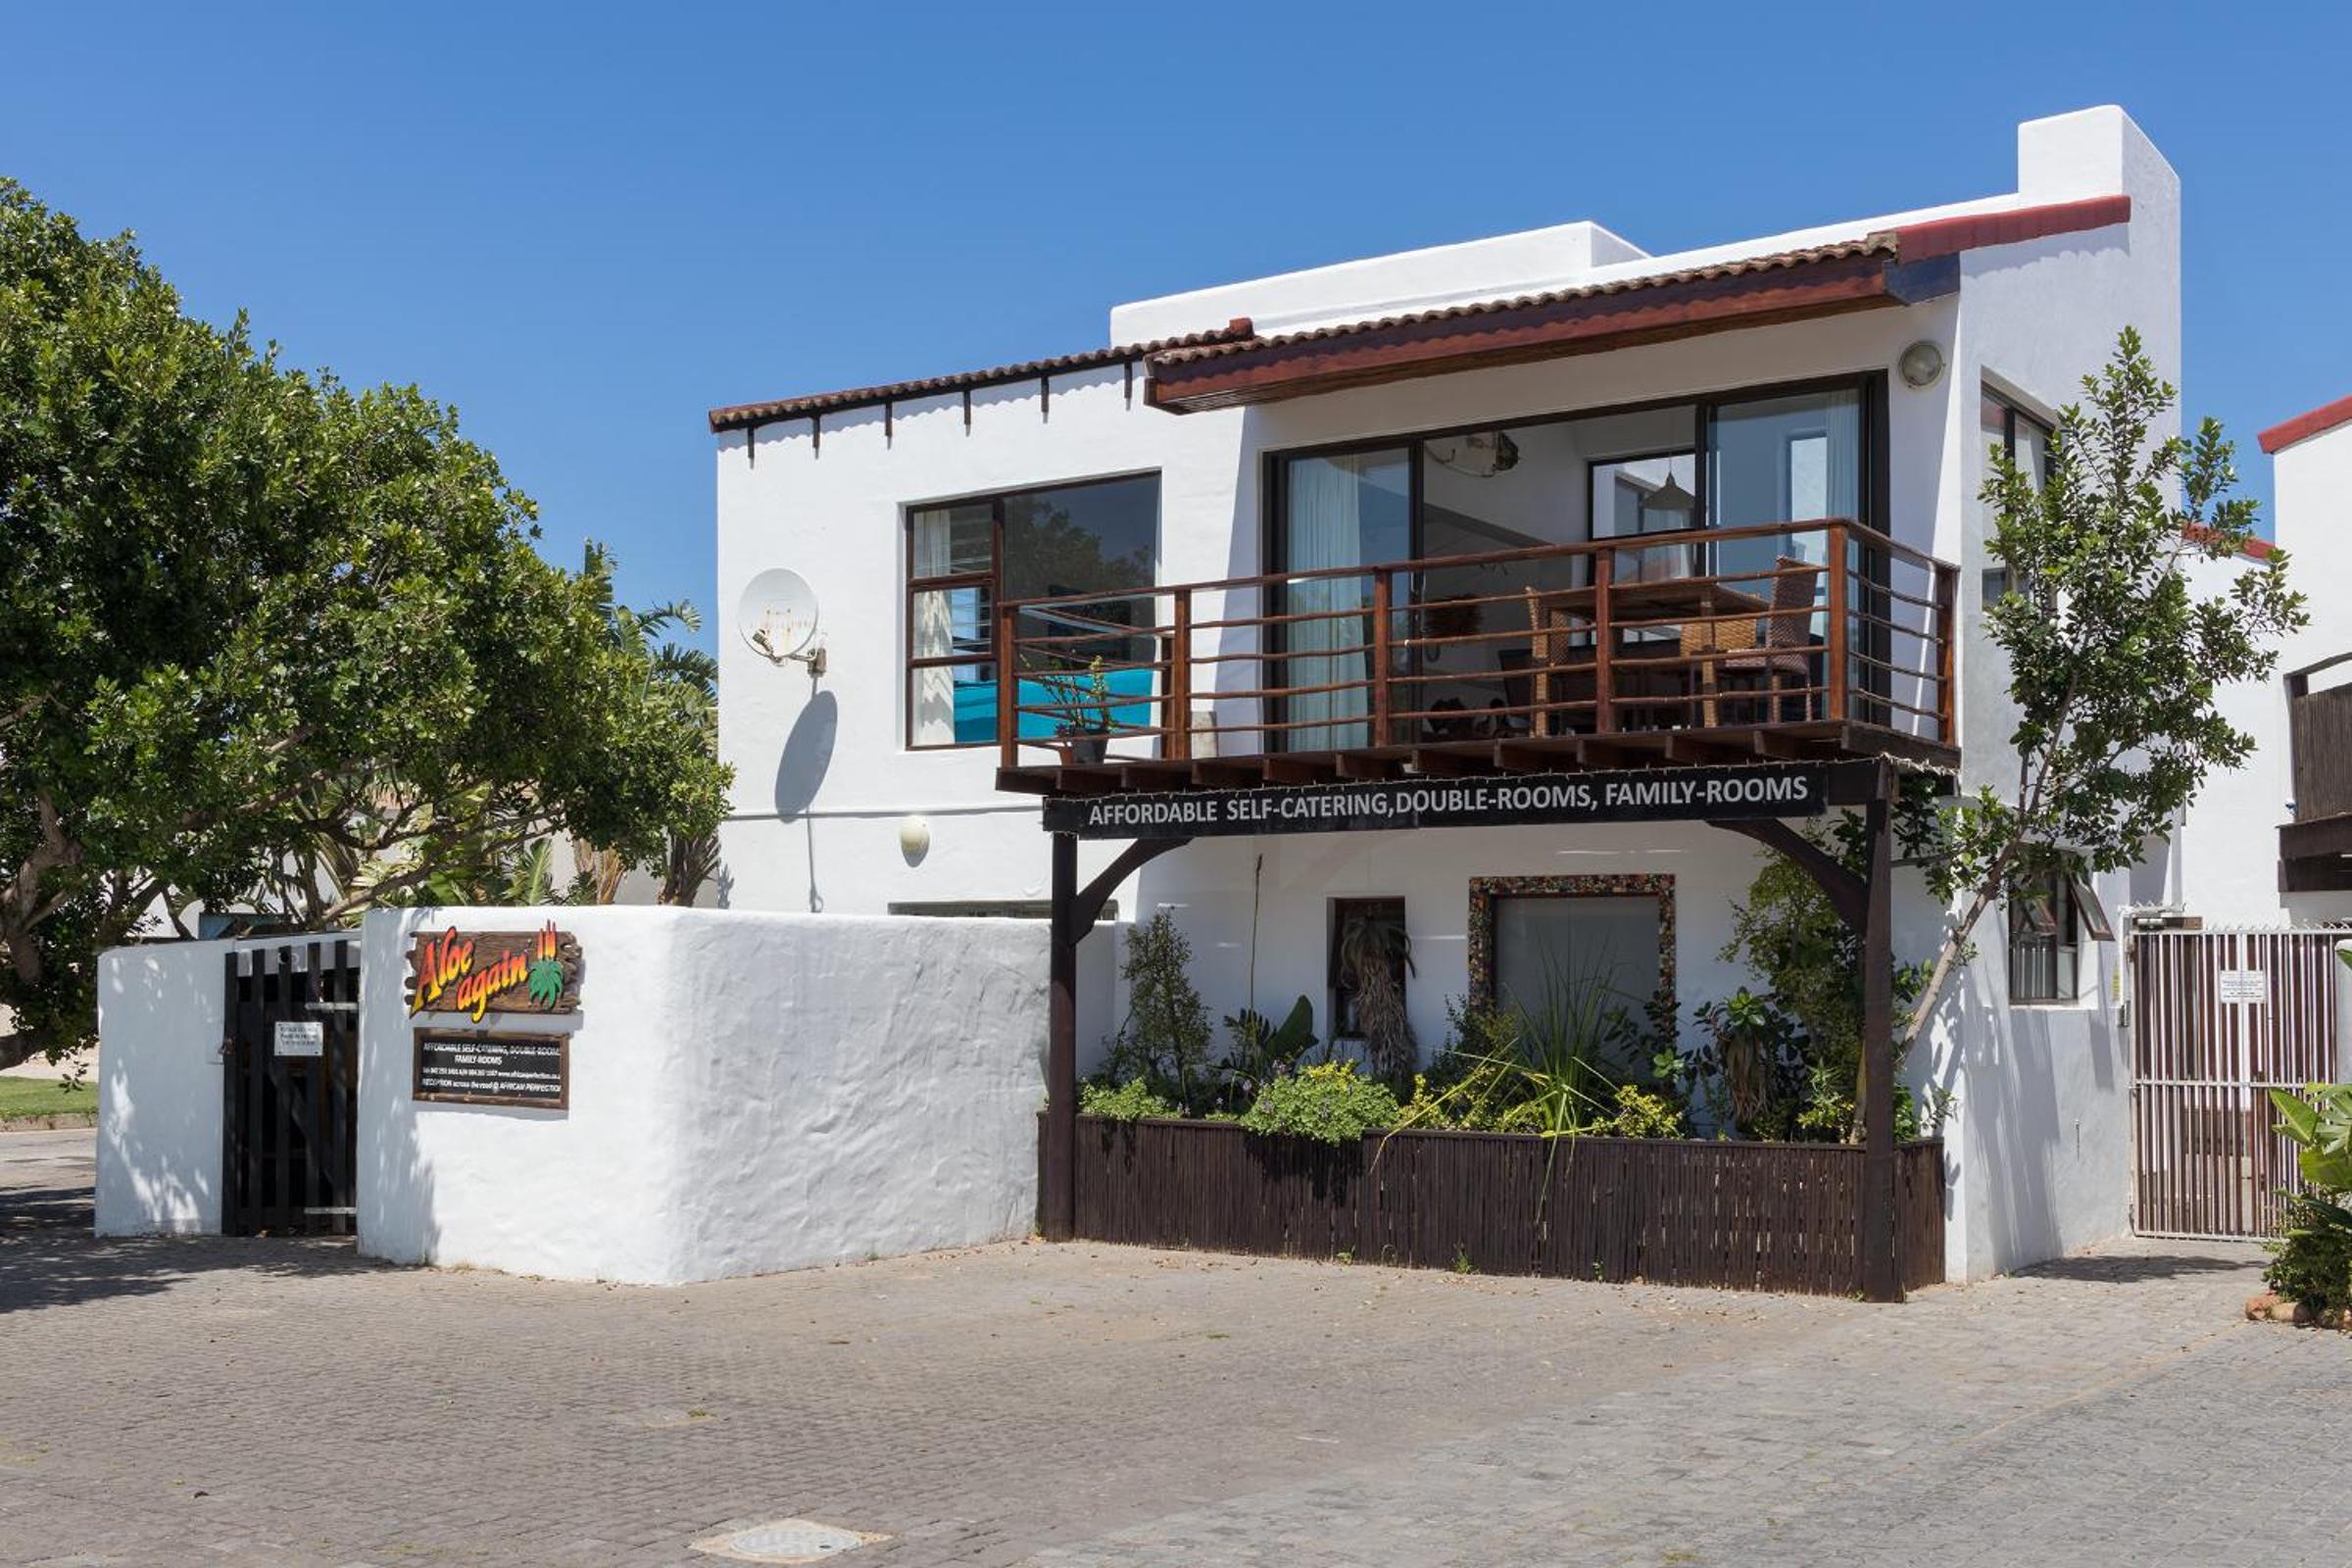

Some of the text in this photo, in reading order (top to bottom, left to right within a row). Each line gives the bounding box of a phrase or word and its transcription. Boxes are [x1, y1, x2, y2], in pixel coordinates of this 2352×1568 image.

[1089, 799, 1218, 826] AFFORDABLE
[1605, 775, 1808, 806] FAMILY-ROOMS
[410, 926, 474, 1019] Aloe
[456, 949, 528, 1023] again
